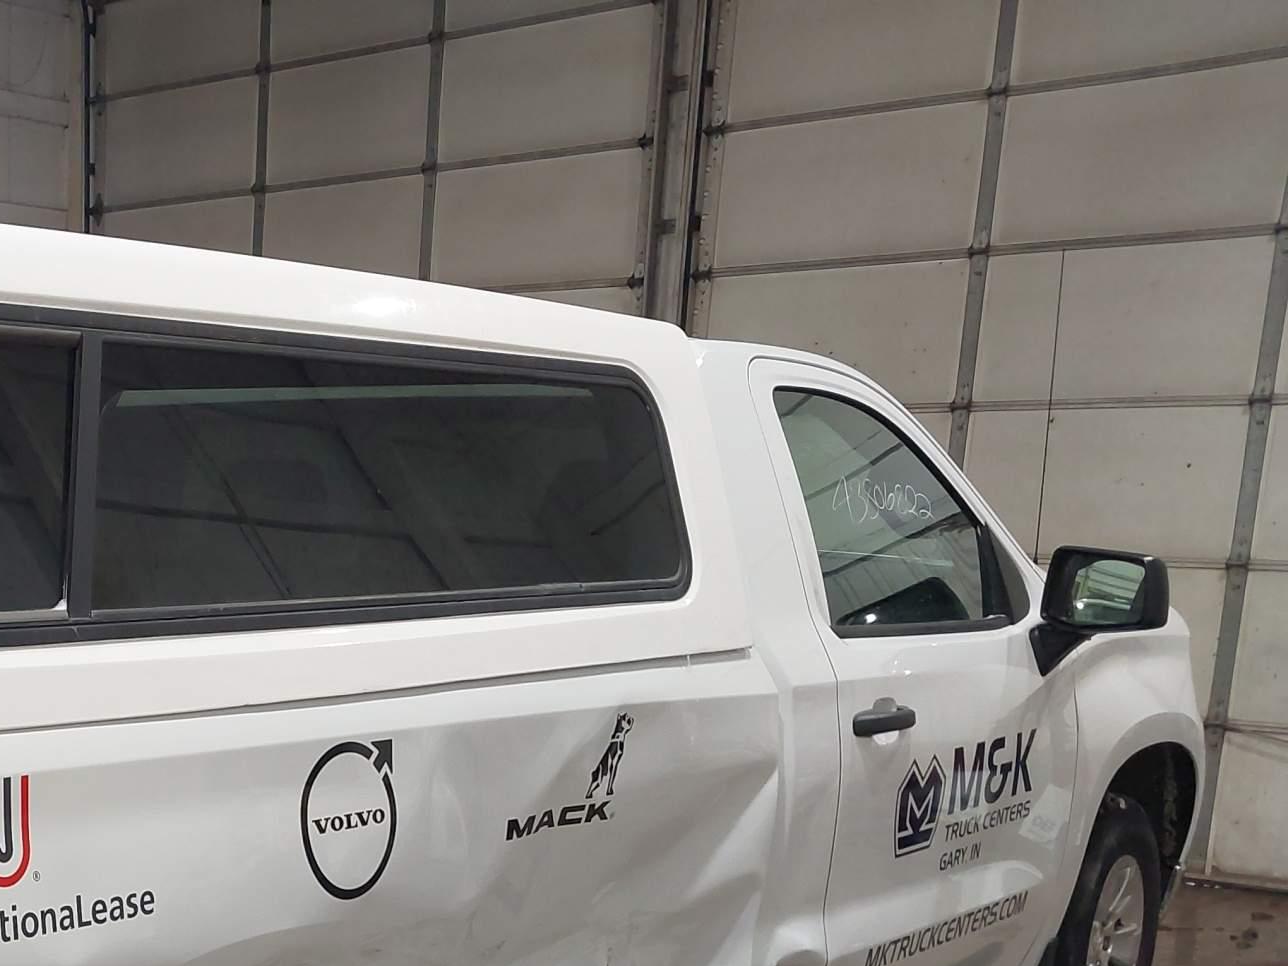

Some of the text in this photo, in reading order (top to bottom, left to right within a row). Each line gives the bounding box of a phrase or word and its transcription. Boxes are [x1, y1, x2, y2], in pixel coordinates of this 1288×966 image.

[947, 728, 1037, 815] M&K
[312, 808, 385, 834] VOLVO
[506, 801, 611, 840] MACK
[944, 815, 980, 842] TRUCK
[982, 801, 1031, 829] CENTERS
[970, 841, 981, 860] IN
